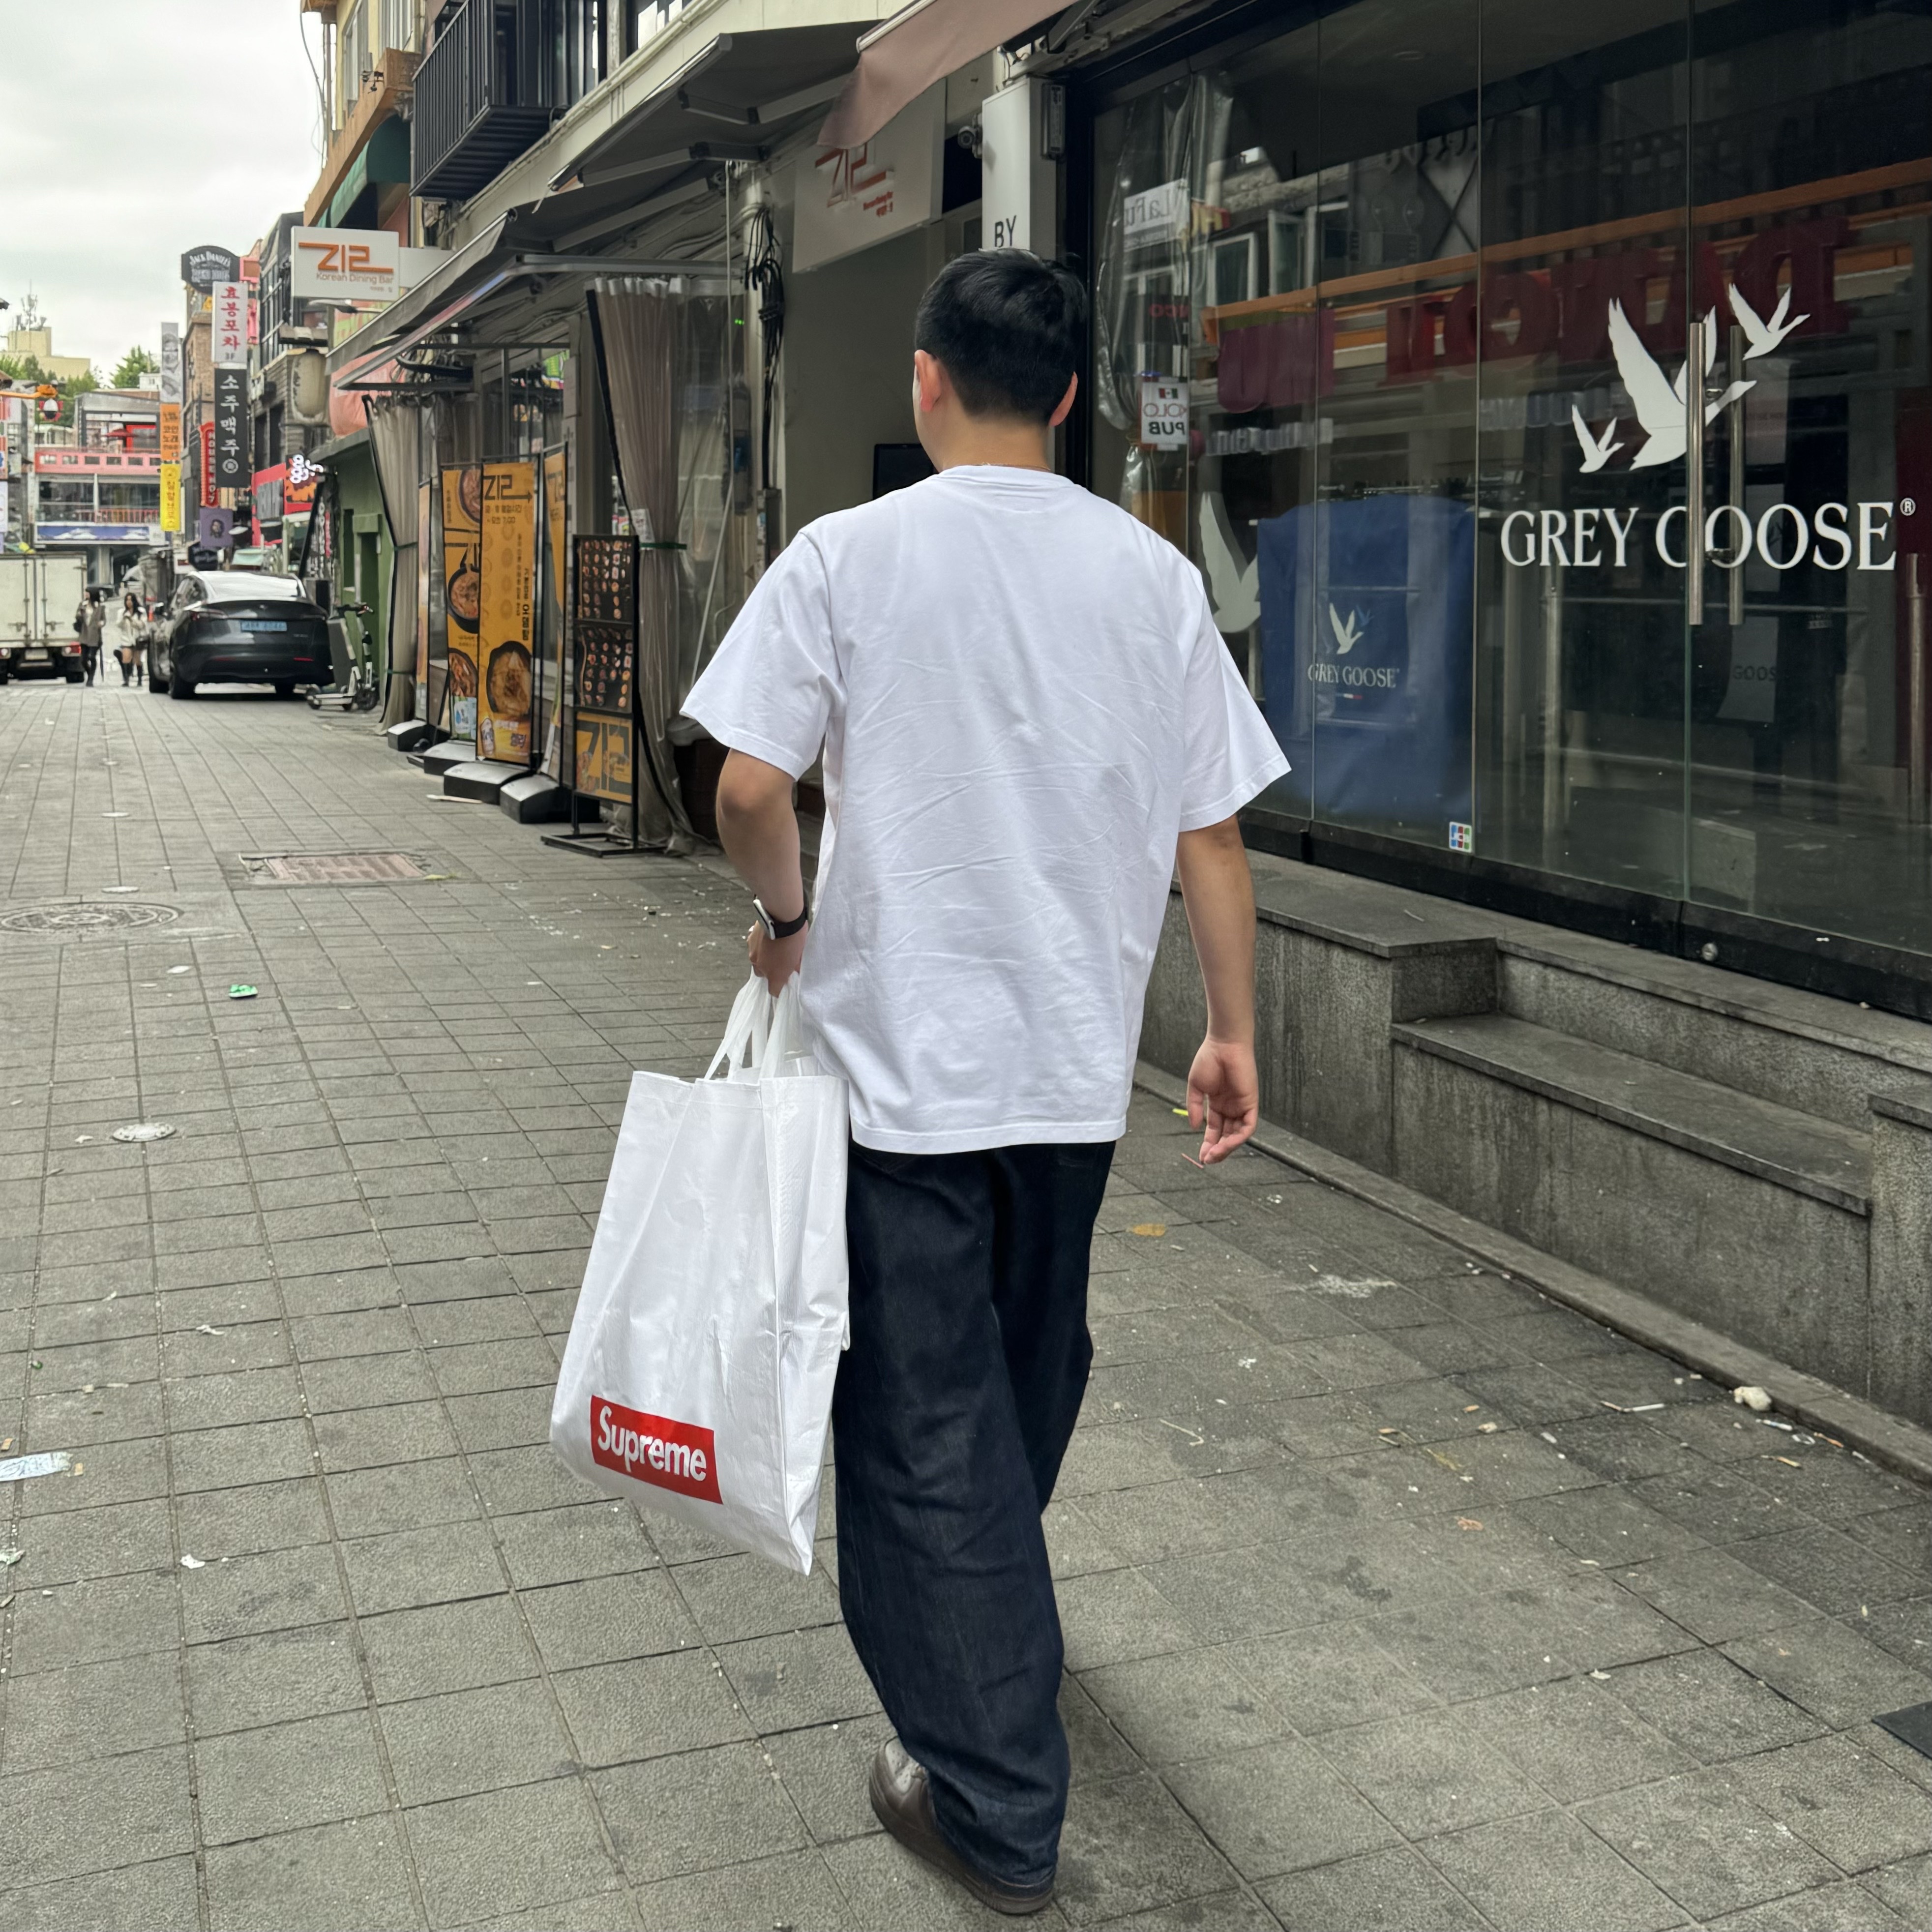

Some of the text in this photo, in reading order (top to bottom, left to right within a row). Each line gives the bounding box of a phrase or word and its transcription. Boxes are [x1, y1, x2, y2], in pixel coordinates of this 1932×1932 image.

[995, 215, 1016, 247] BY
[317, 272, 347, 282] Korean
[350, 274, 377, 285] Dining
[220, 375, 240, 456] 소주맥주
[1500, 507, 1640, 567] GREY
[1308, 663, 1397, 688] GREY GOOSE
[597, 1405, 707, 1482] Supreme
